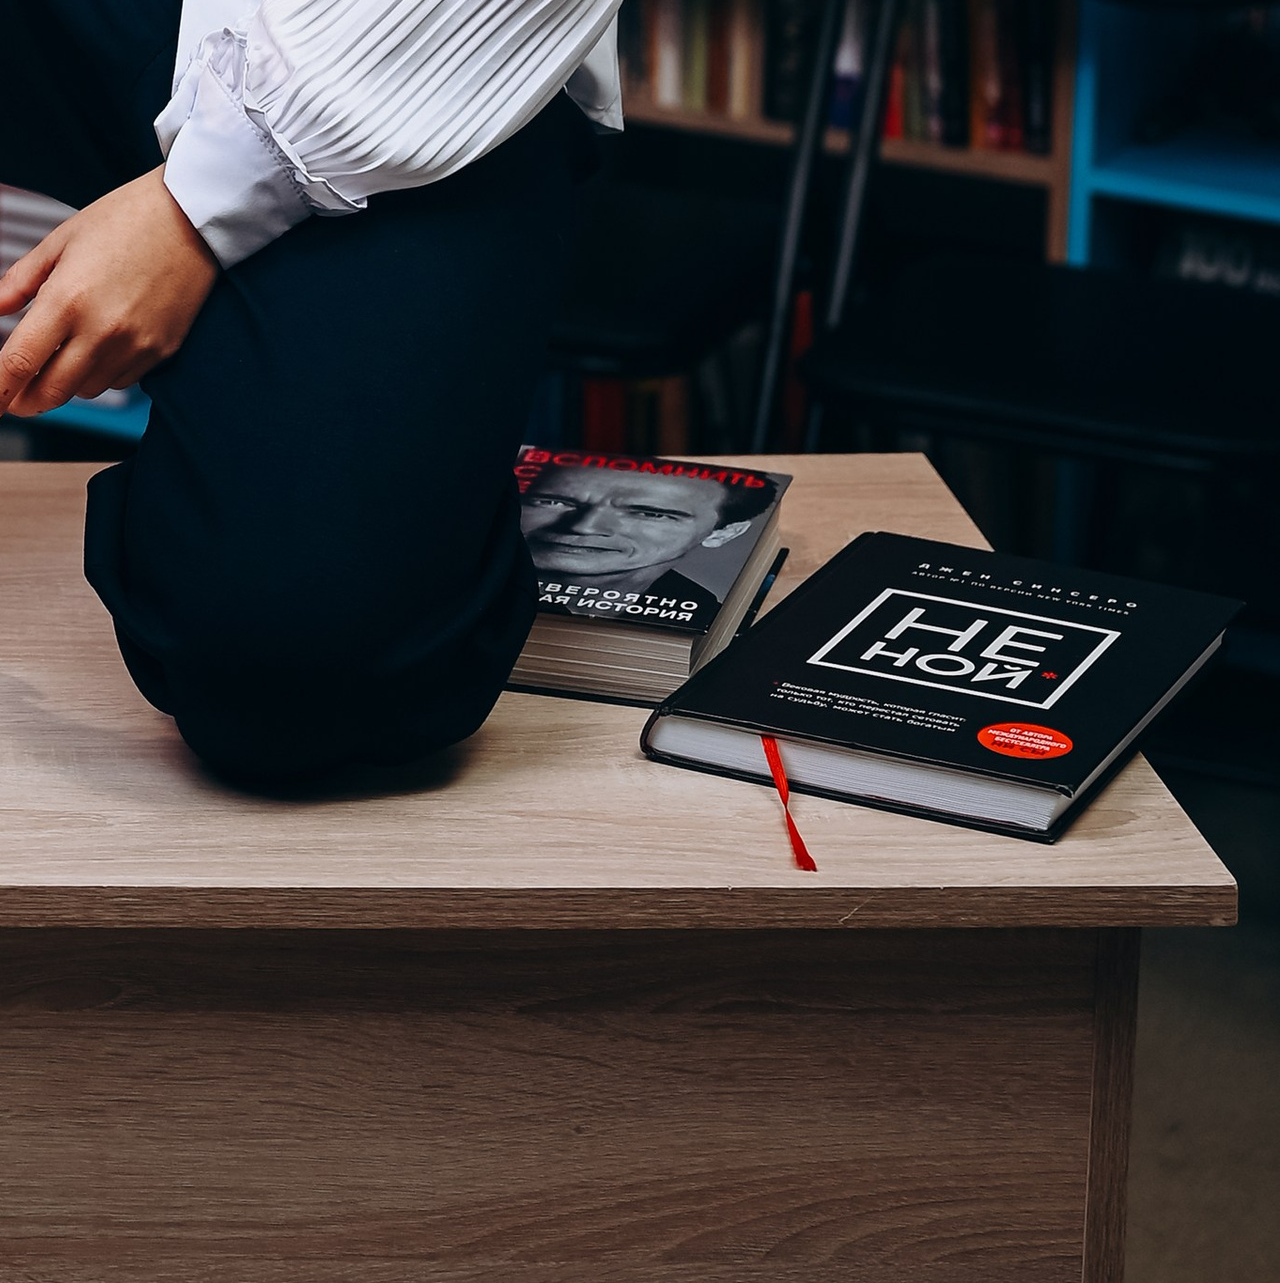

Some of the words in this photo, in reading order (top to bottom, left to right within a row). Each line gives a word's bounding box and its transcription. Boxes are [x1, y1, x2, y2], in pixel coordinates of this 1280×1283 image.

[523, 448, 766, 489] ВСПОМНИТЬ
[538, 580, 699, 612] ВЕРОЯТНО
[911, 570, 946, 580] АВТОР
[970, 580, 986, 588] ПО
[989, 584, 1033, 597] ВЕРСИИ
[1037, 593, 1061, 602] NEW
[1065, 599, 1092, 608] YORK
[1098, 605, 1130, 615] TIMES
[918, 562, 991, 580] ДЖЕН
[1012, 579, 1137, 608] СИНСЕРО
[576, 597, 693, 622] ИСТОРИЯ
[884, 607, 1064, 667] НЕ
[860, 641, 1033, 689] НОЙ
[777, 688, 813, 699] только
[816, 695, 833, 704] тот,
[858, 703, 910, 718] перестал
[912, 714, 960, 728] сетовать
[781, 682, 826, 695] Вековая
[828, 691, 880, 706] мудрость,
[883, 702, 926, 715] которая
[787, 695, 828, 708] судьбу,
[832, 704, 870, 716] может
[872, 713, 903, 723] стать
[906, 719, 956, 733] богатым
[987, 729, 1067, 749] МЕЖДУНАРОДНОГО
[994, 736, 1051, 752] БЕСТСЕЛЛЕРА
[1022, 730, 1053, 741] АВТОРА
